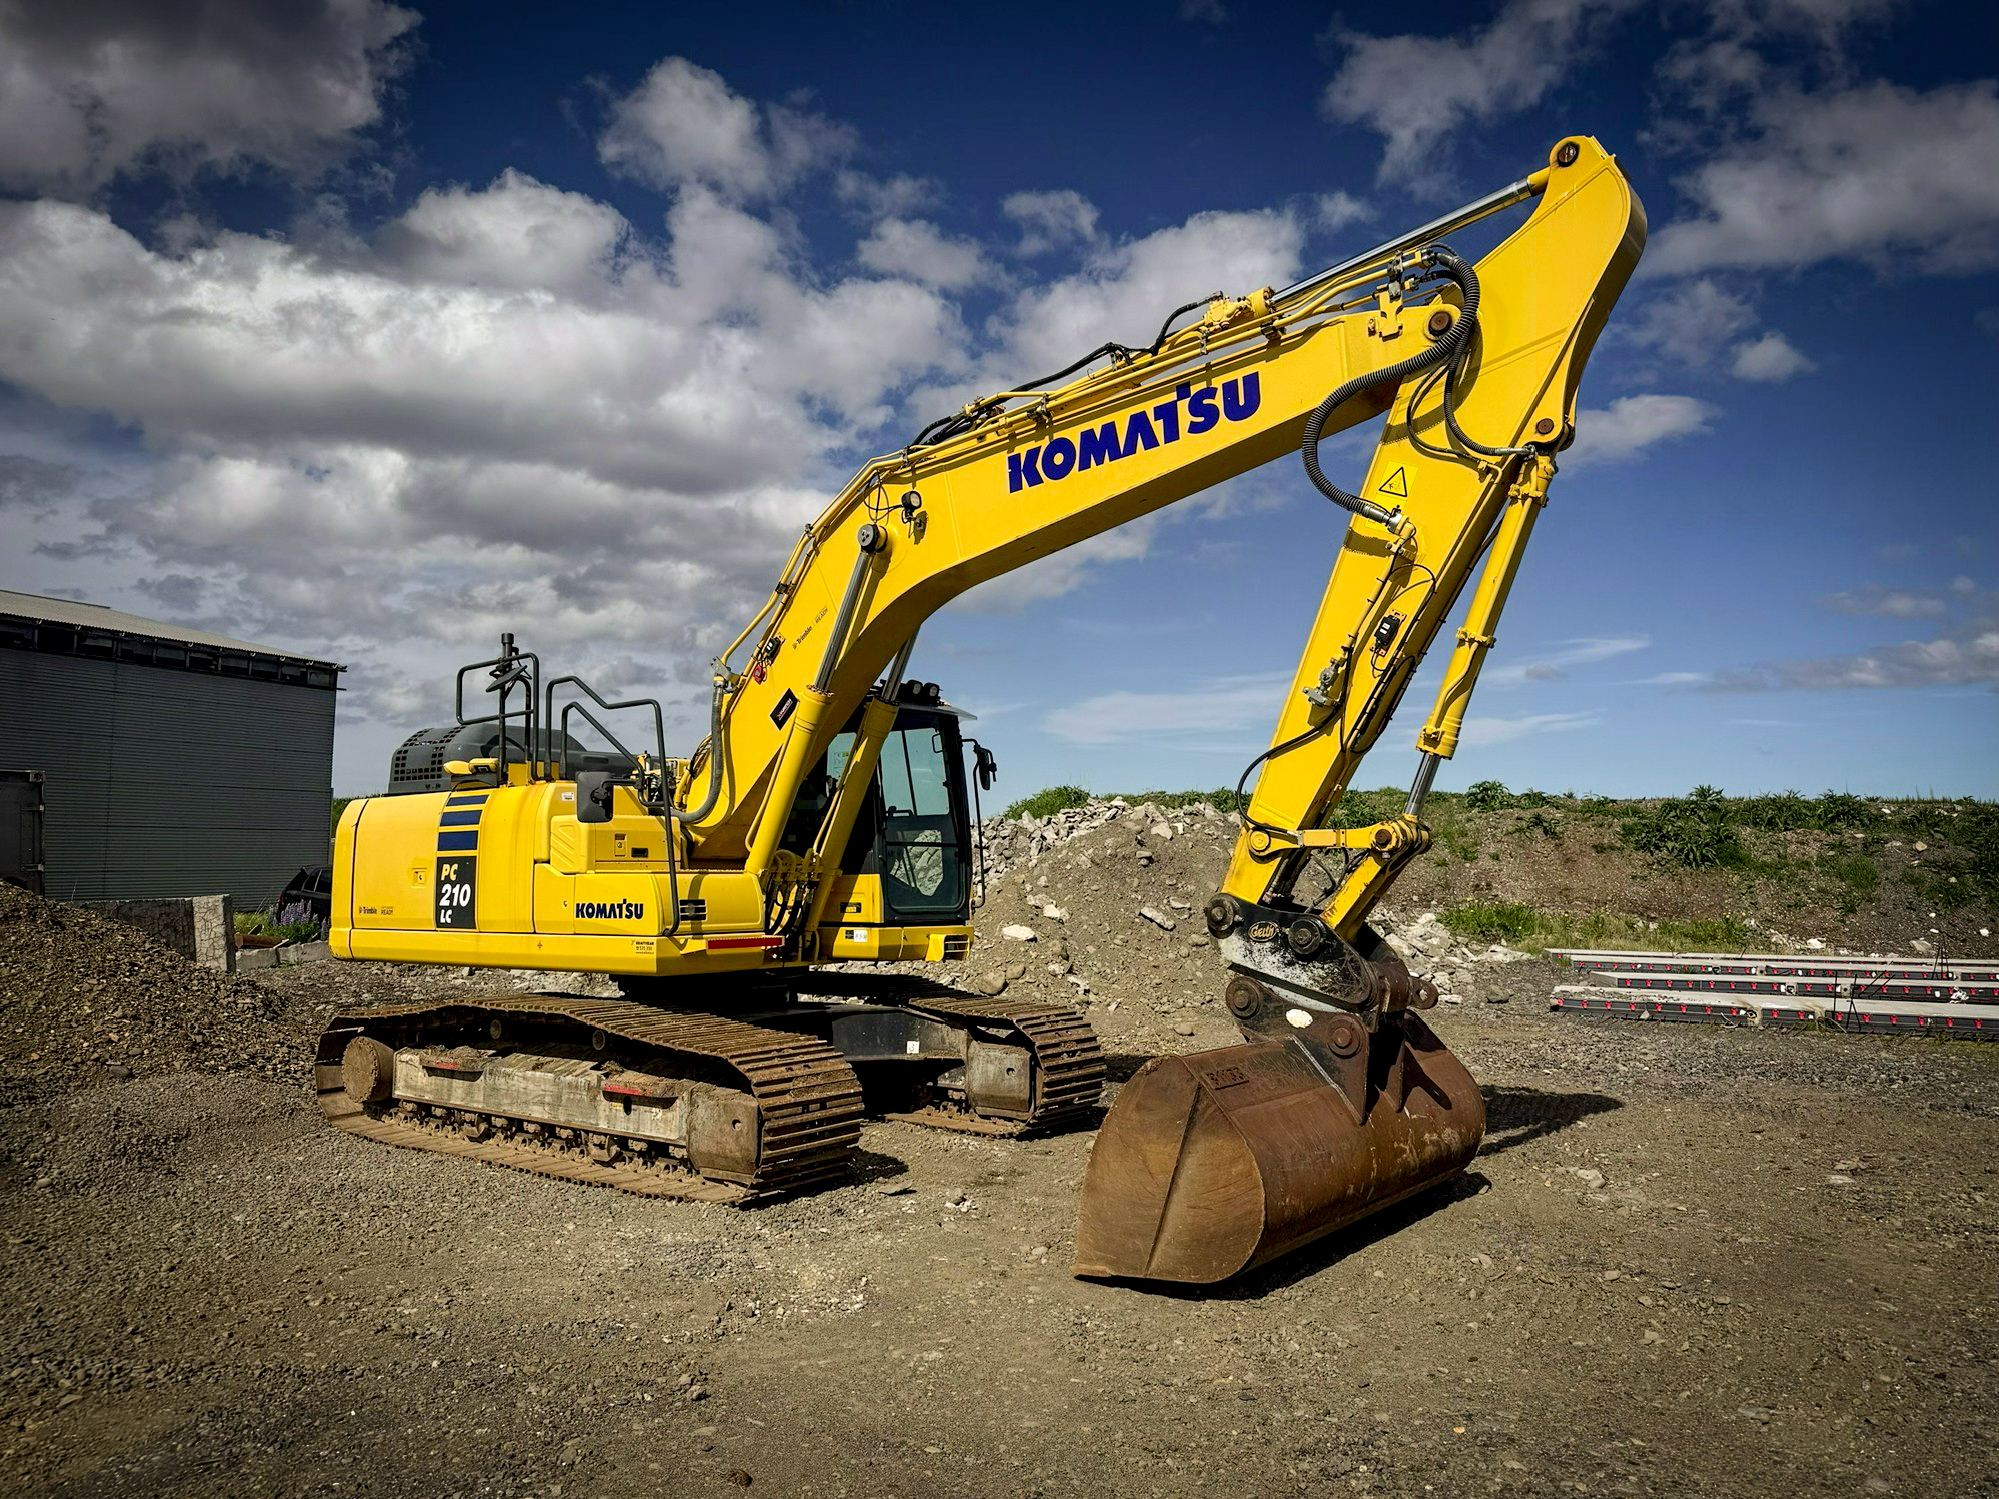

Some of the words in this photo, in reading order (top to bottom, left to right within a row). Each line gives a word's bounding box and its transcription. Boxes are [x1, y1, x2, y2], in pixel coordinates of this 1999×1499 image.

[1008, 371, 1261, 493] KOMATSU
[441, 863, 458, 881] PC
[439, 883, 471, 907] 210
[440, 909, 453, 924] LC
[575, 898, 644, 919] KOMATSU
